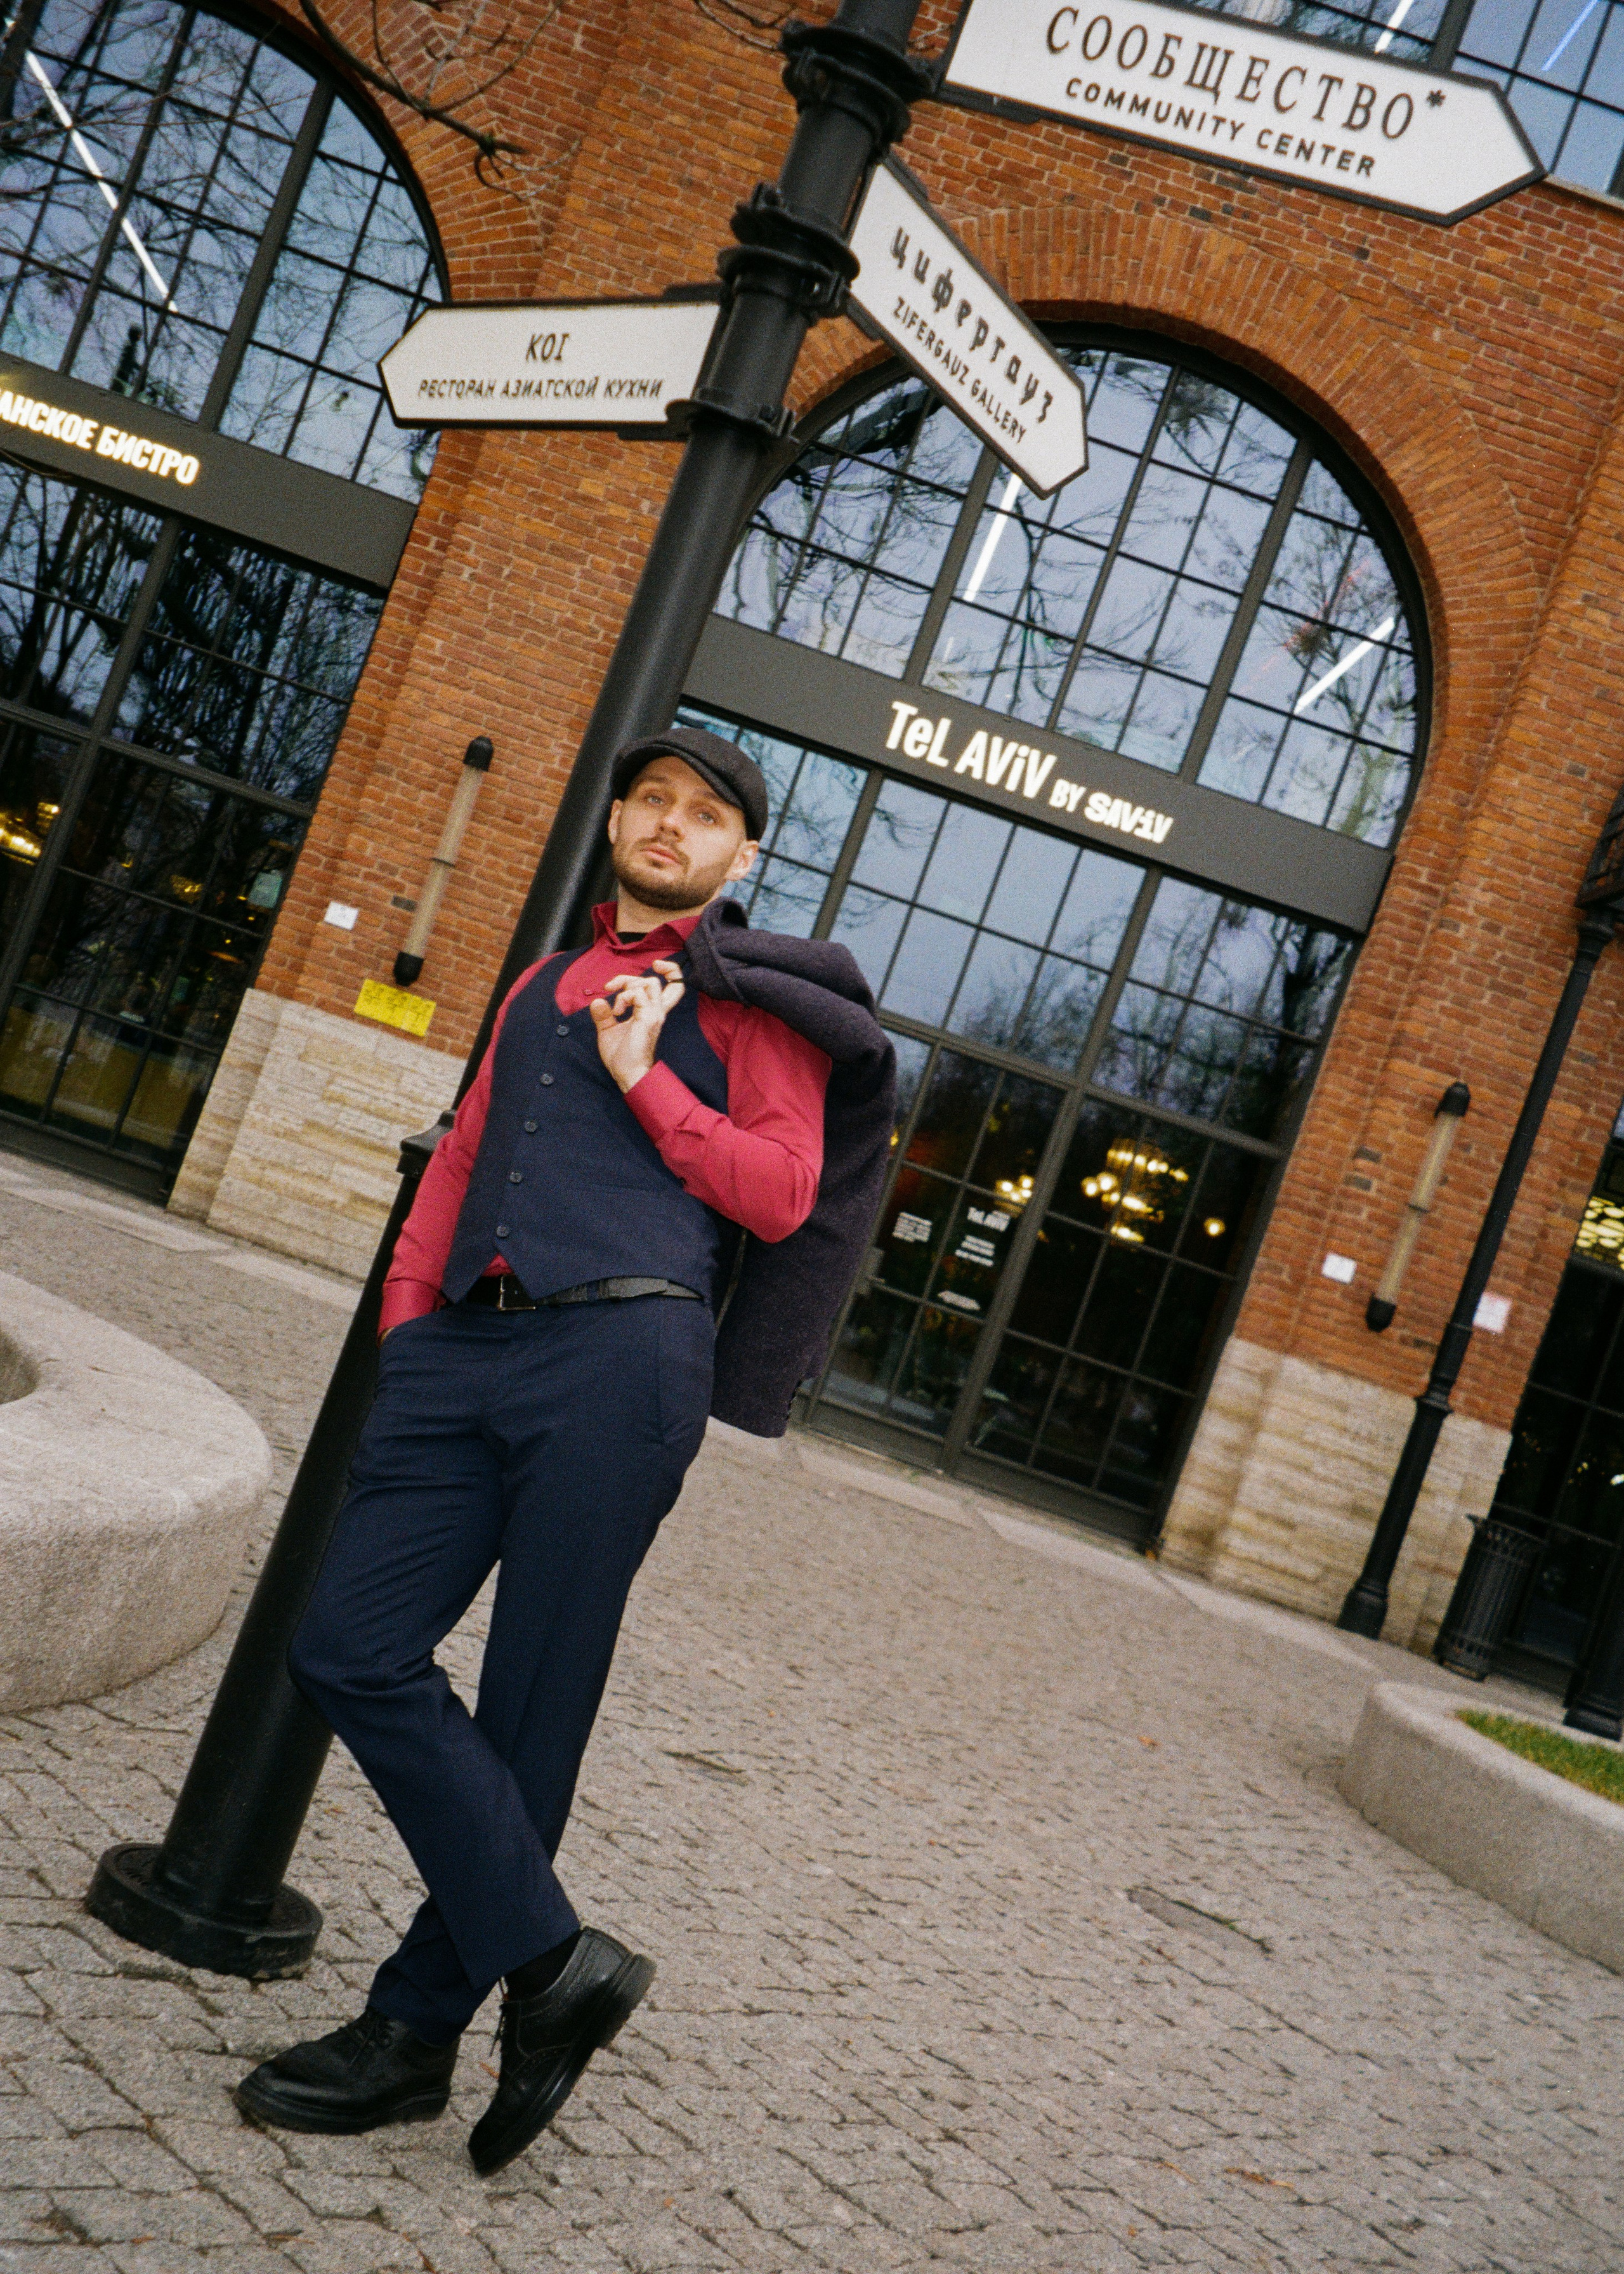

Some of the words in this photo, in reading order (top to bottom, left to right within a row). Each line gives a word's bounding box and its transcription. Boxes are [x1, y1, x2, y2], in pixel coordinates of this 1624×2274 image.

[1066, 77, 1244, 141] COMMUNITY
[1257, 129, 1375, 177] CENTER
[525, 332, 570, 362] KOI
[893, 296, 969, 385] ZIFERGAUZ
[971, 379, 1027, 444] GALLERY
[418, 379, 496, 398] РЕСТОРАН
[500, 376, 600, 399] АЗИАТСКОЙ
[603, 379, 665, 398] КУХНИ
[96, 426, 200, 485] БИСТРО
[1049, 779, 1086, 812] BY
